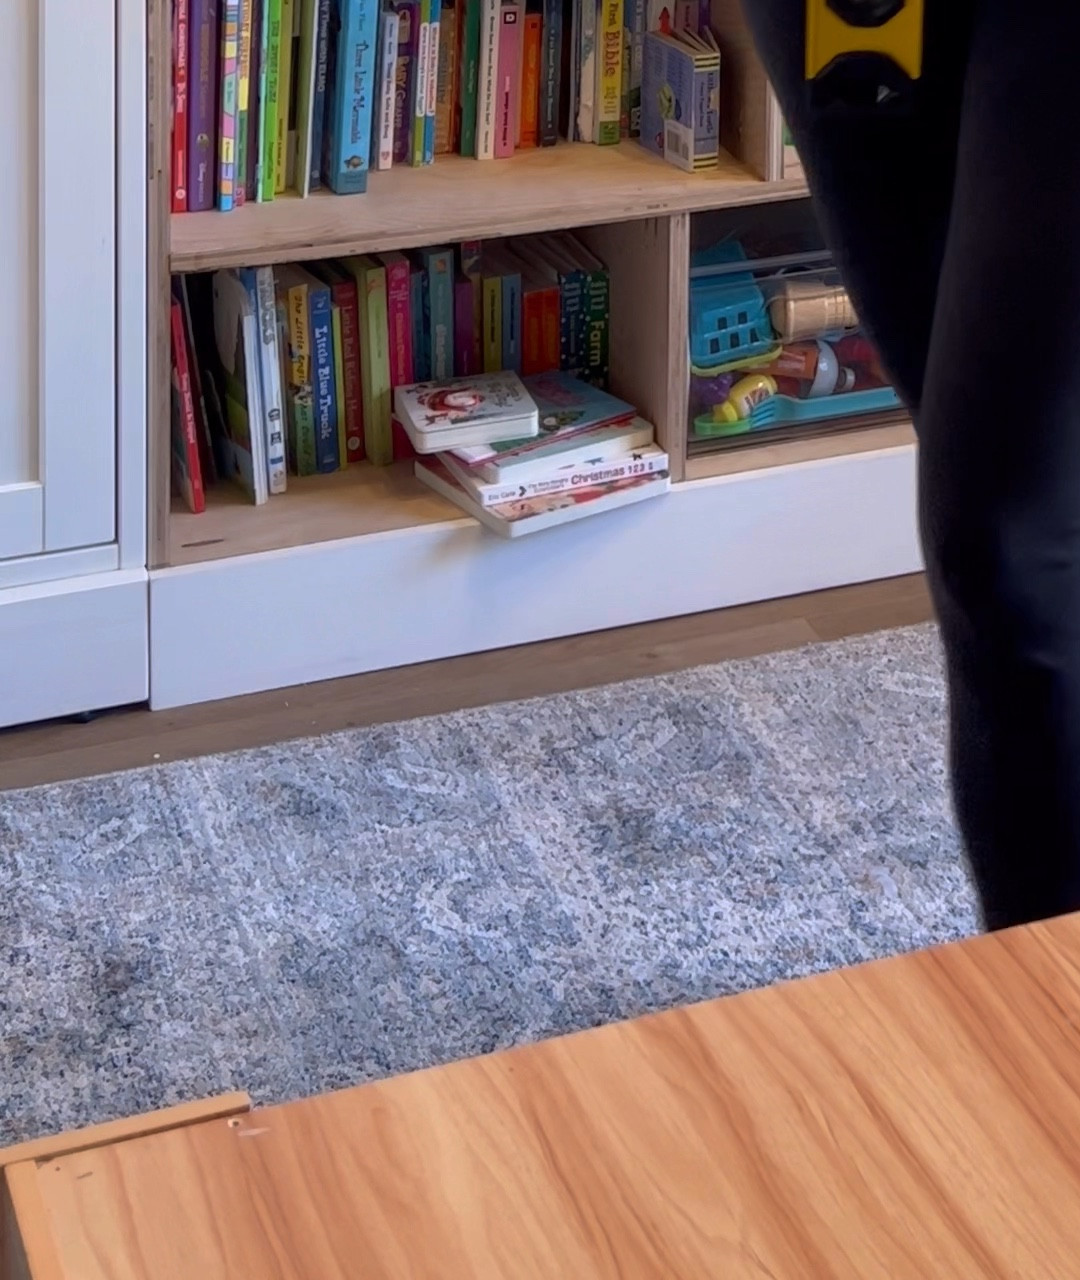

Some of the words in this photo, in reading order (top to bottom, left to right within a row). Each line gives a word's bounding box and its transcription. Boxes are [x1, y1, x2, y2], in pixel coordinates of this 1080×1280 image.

[320, 15, 330, 38] Time
[608, 3, 619, 27] First
[177, 22, 186, 68] CHRISTMAS
[318, 39, 328, 63] with
[354, 39, 369, 68] Three
[604, 30, 621, 78] Bible
[316, 64, 327, 92] ELMO
[353, 71, 367, 94] Little
[395, 56, 410, 88] BABY
[350, 98, 365, 145] Mermaids
[294, 295, 303, 314] The
[341, 306, 354, 334] Little
[295, 317, 305, 350] Little
[315, 325, 328, 364] Little
[343, 337, 355, 359] Red
[589, 320, 606, 366] Farm
[295, 354, 306, 385] Engin
[317, 365, 330, 396] Blue
[343, 361, 357, 397] Riding
[319, 395, 332, 440] Truck
[346, 400, 359, 432] Hood
[570, 467, 626, 485] Christmas
